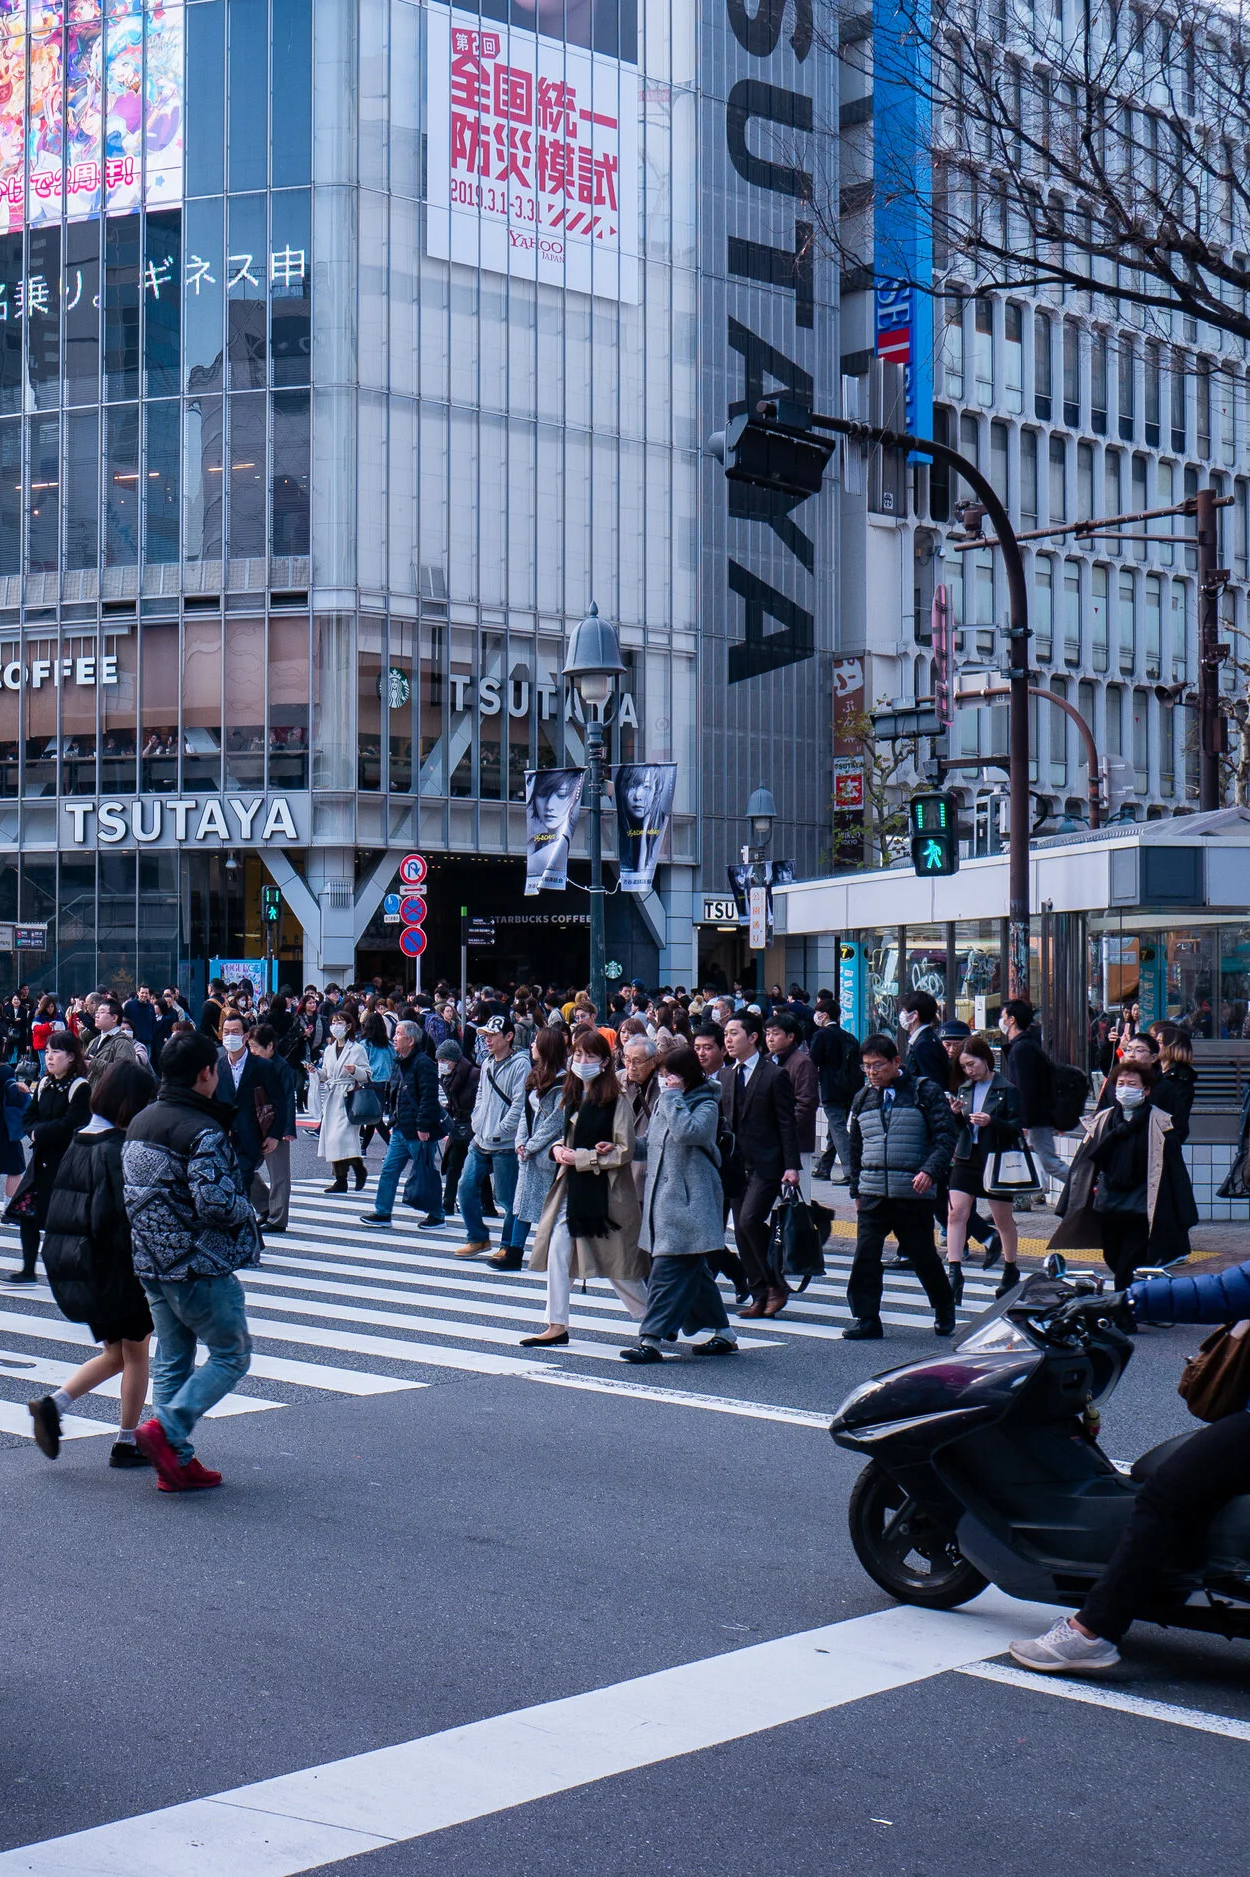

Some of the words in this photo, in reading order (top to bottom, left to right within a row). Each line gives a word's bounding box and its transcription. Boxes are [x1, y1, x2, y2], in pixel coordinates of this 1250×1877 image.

[455, 32, 497, 55] 第2回
[451, 55, 618, 139] 全国統一
[451, 111, 618, 211] 防災模試
[541, 251, 565, 263] JAPAN
[65, 798, 298, 843] TSUTAYA
[550, 914, 591, 923] COFFEE
[704, 902, 735, 919] TSU
